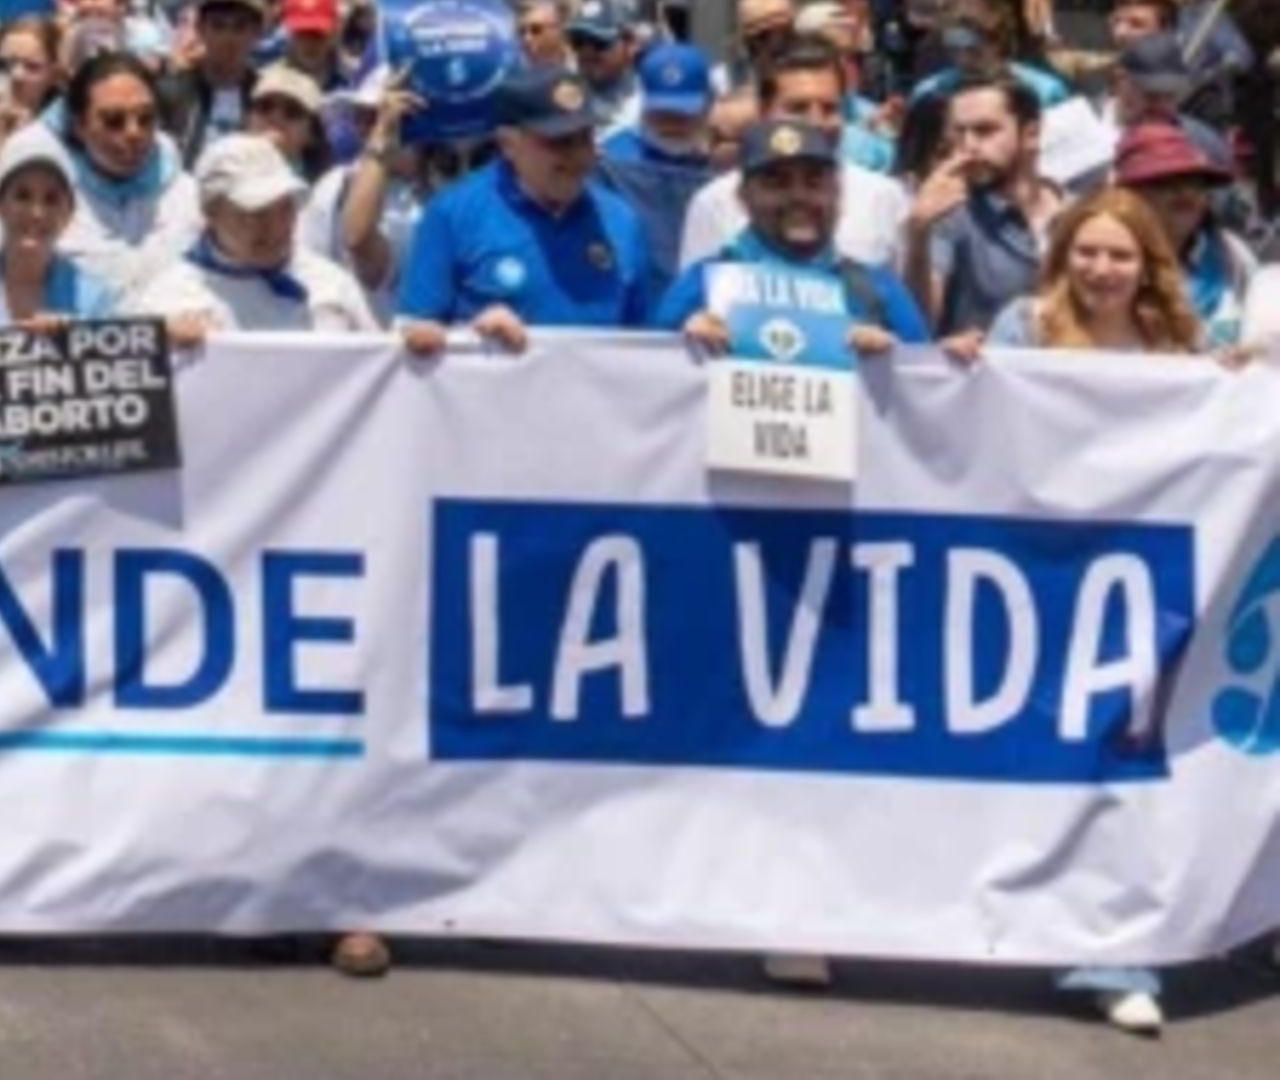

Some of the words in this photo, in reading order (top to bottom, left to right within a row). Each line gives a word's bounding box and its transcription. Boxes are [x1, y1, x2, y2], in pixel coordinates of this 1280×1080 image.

[68, 323, 157, 360] POR
[7, 364, 75, 400] FIN
[84, 358, 167, 395] DEL
[731, 370, 796, 413] ELIGE
[804, 377, 833, 416] LA
[754, 421, 808, 459] VIDA
[469, 531, 650, 722] LA
[732, 535, 1160, 744] VIDA
